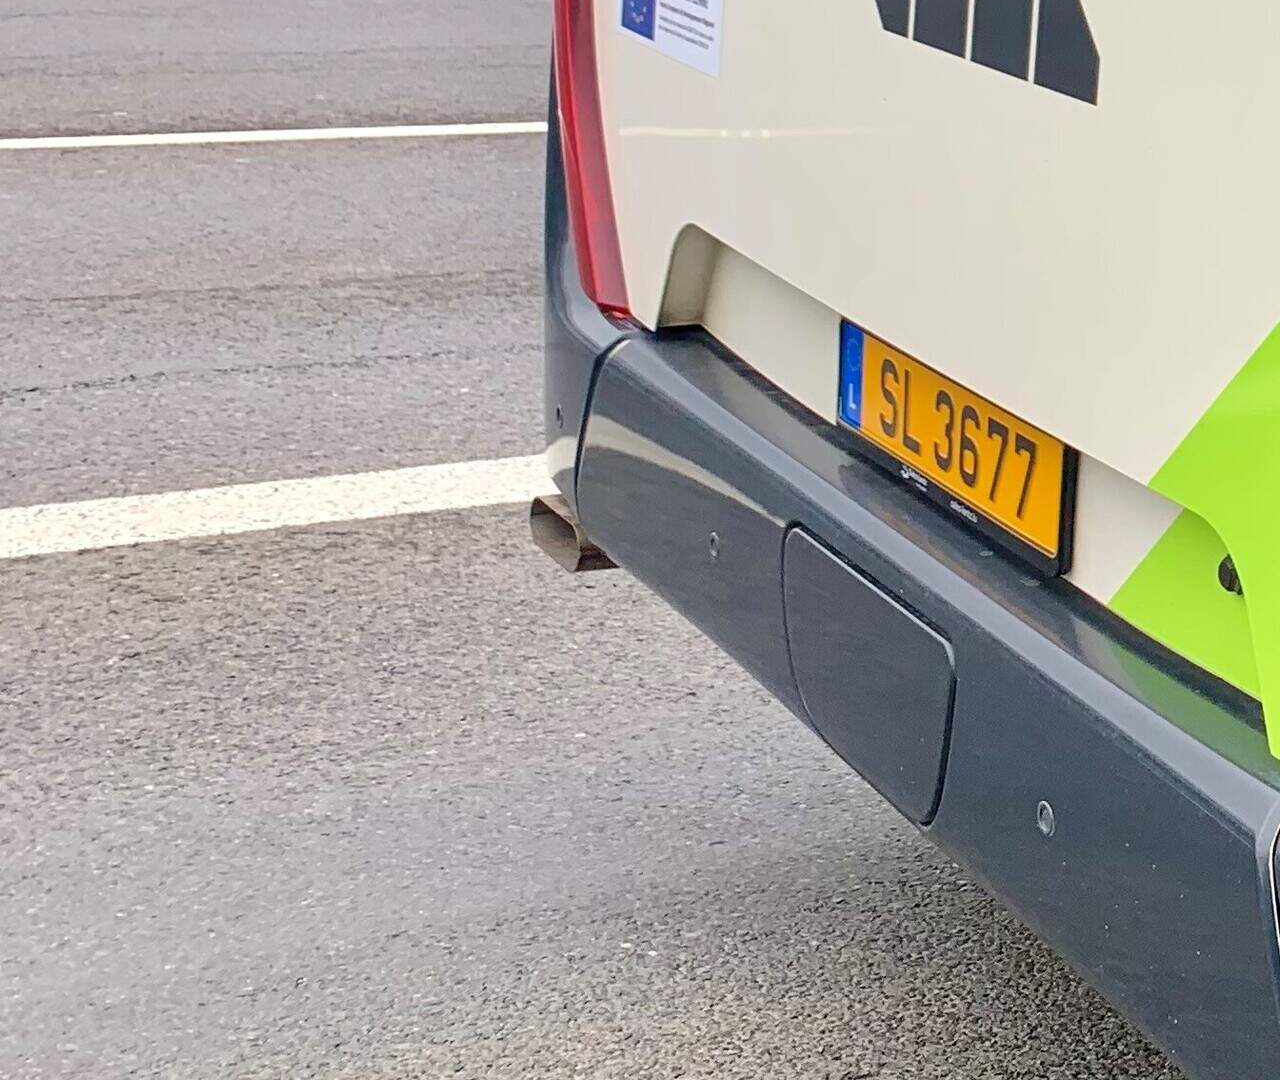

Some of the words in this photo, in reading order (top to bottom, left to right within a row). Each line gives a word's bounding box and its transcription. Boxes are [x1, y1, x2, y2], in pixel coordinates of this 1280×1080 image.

[848, 383, 856, 409] L
[880, 358, 922, 455] SL
[934, 390, 1036, 520] 3677
